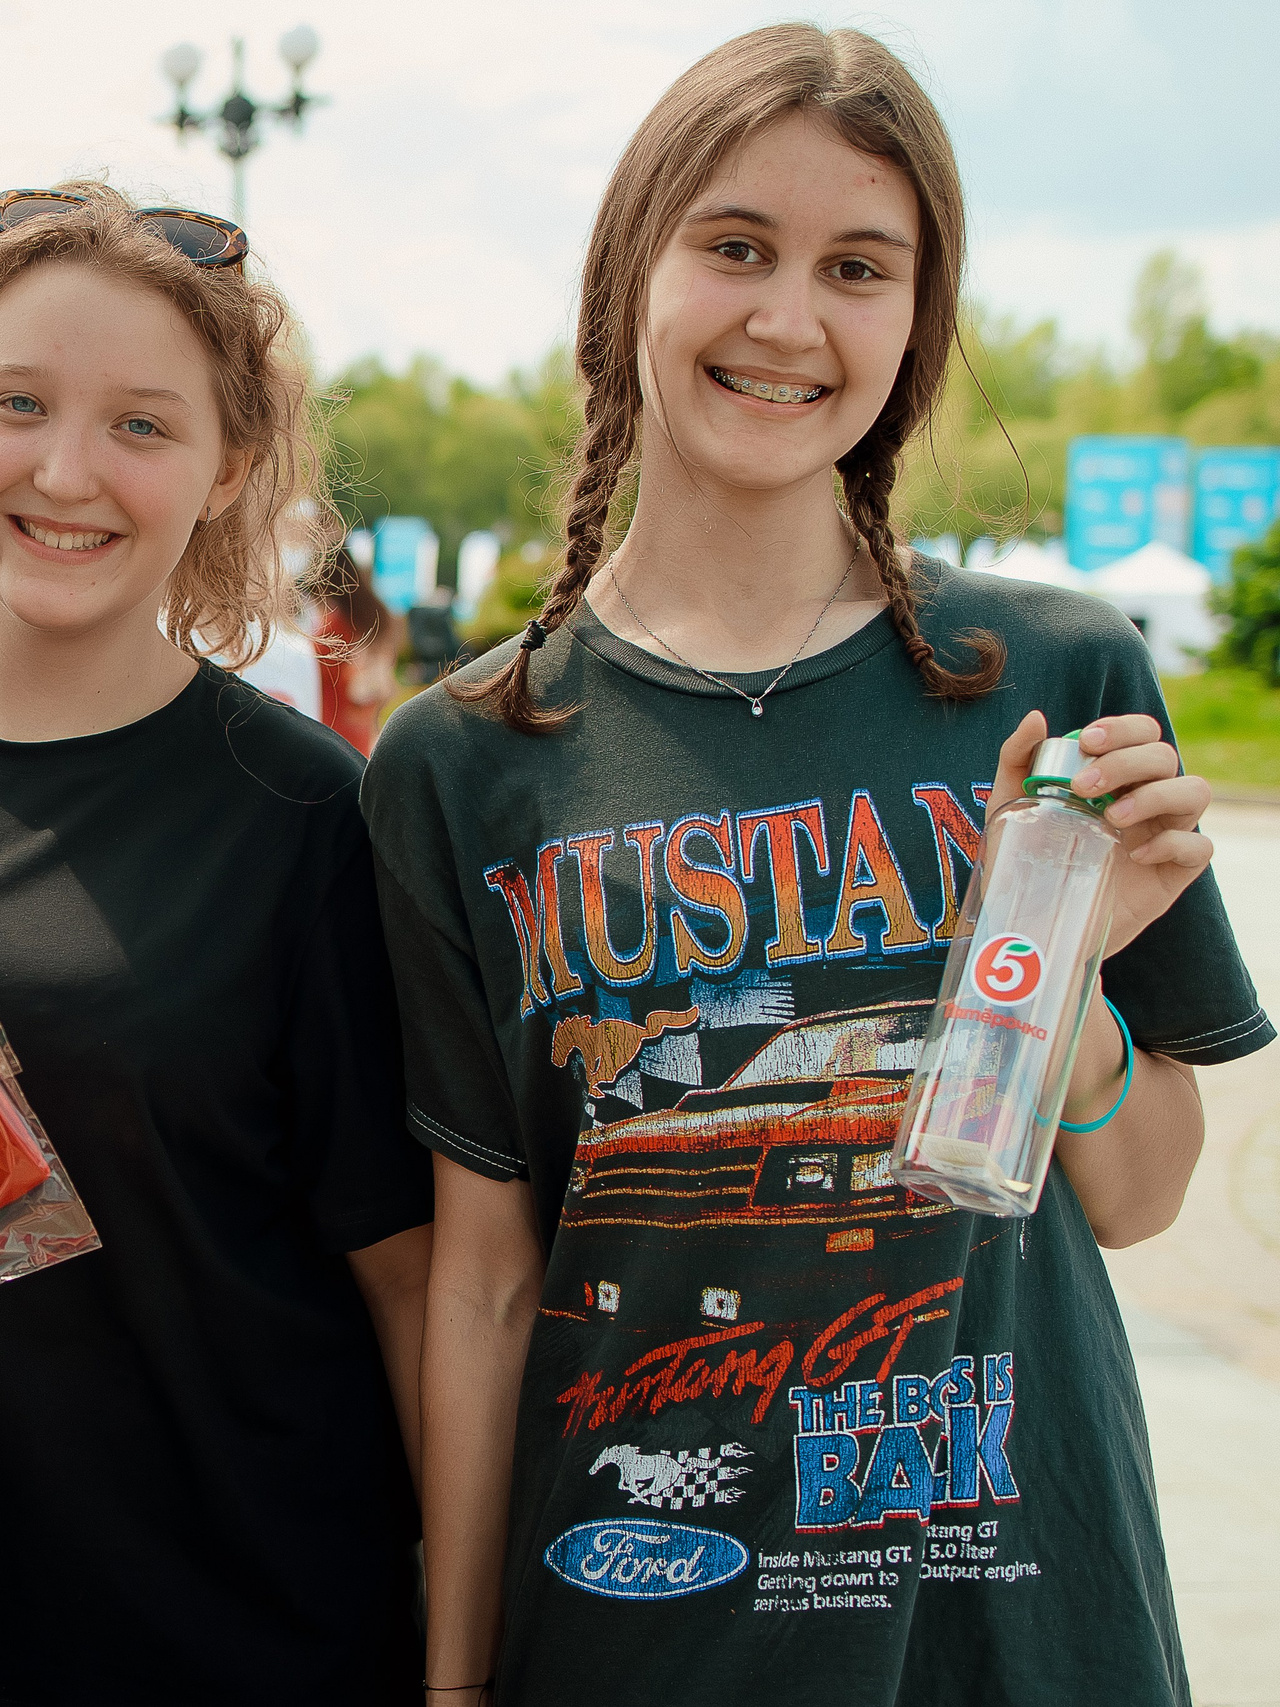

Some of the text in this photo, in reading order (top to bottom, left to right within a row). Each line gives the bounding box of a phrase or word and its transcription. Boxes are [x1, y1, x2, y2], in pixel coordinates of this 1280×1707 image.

[483, 783, 995, 1022] MUSTAN
[985, 939, 1033, 992] 5
[801, 1276, 964, 1387] GT
[789, 1351, 1014, 1437] THE BOS IS
[793, 1400, 1021, 1533] BAK
[580, 1526, 706, 1586] Ford
[758, 1548, 800, 1569] Inside
[885, 1545, 913, 1564] GT.
[929, 1542, 958, 1560] 5.0
[960, 1542, 998, 1560] liter
[984, 1560, 1042, 1583] engine.
[813, 1590, 892, 1610] business.
[820, 1571, 874, 1588] down
[878, 1570, 900, 1586] to
